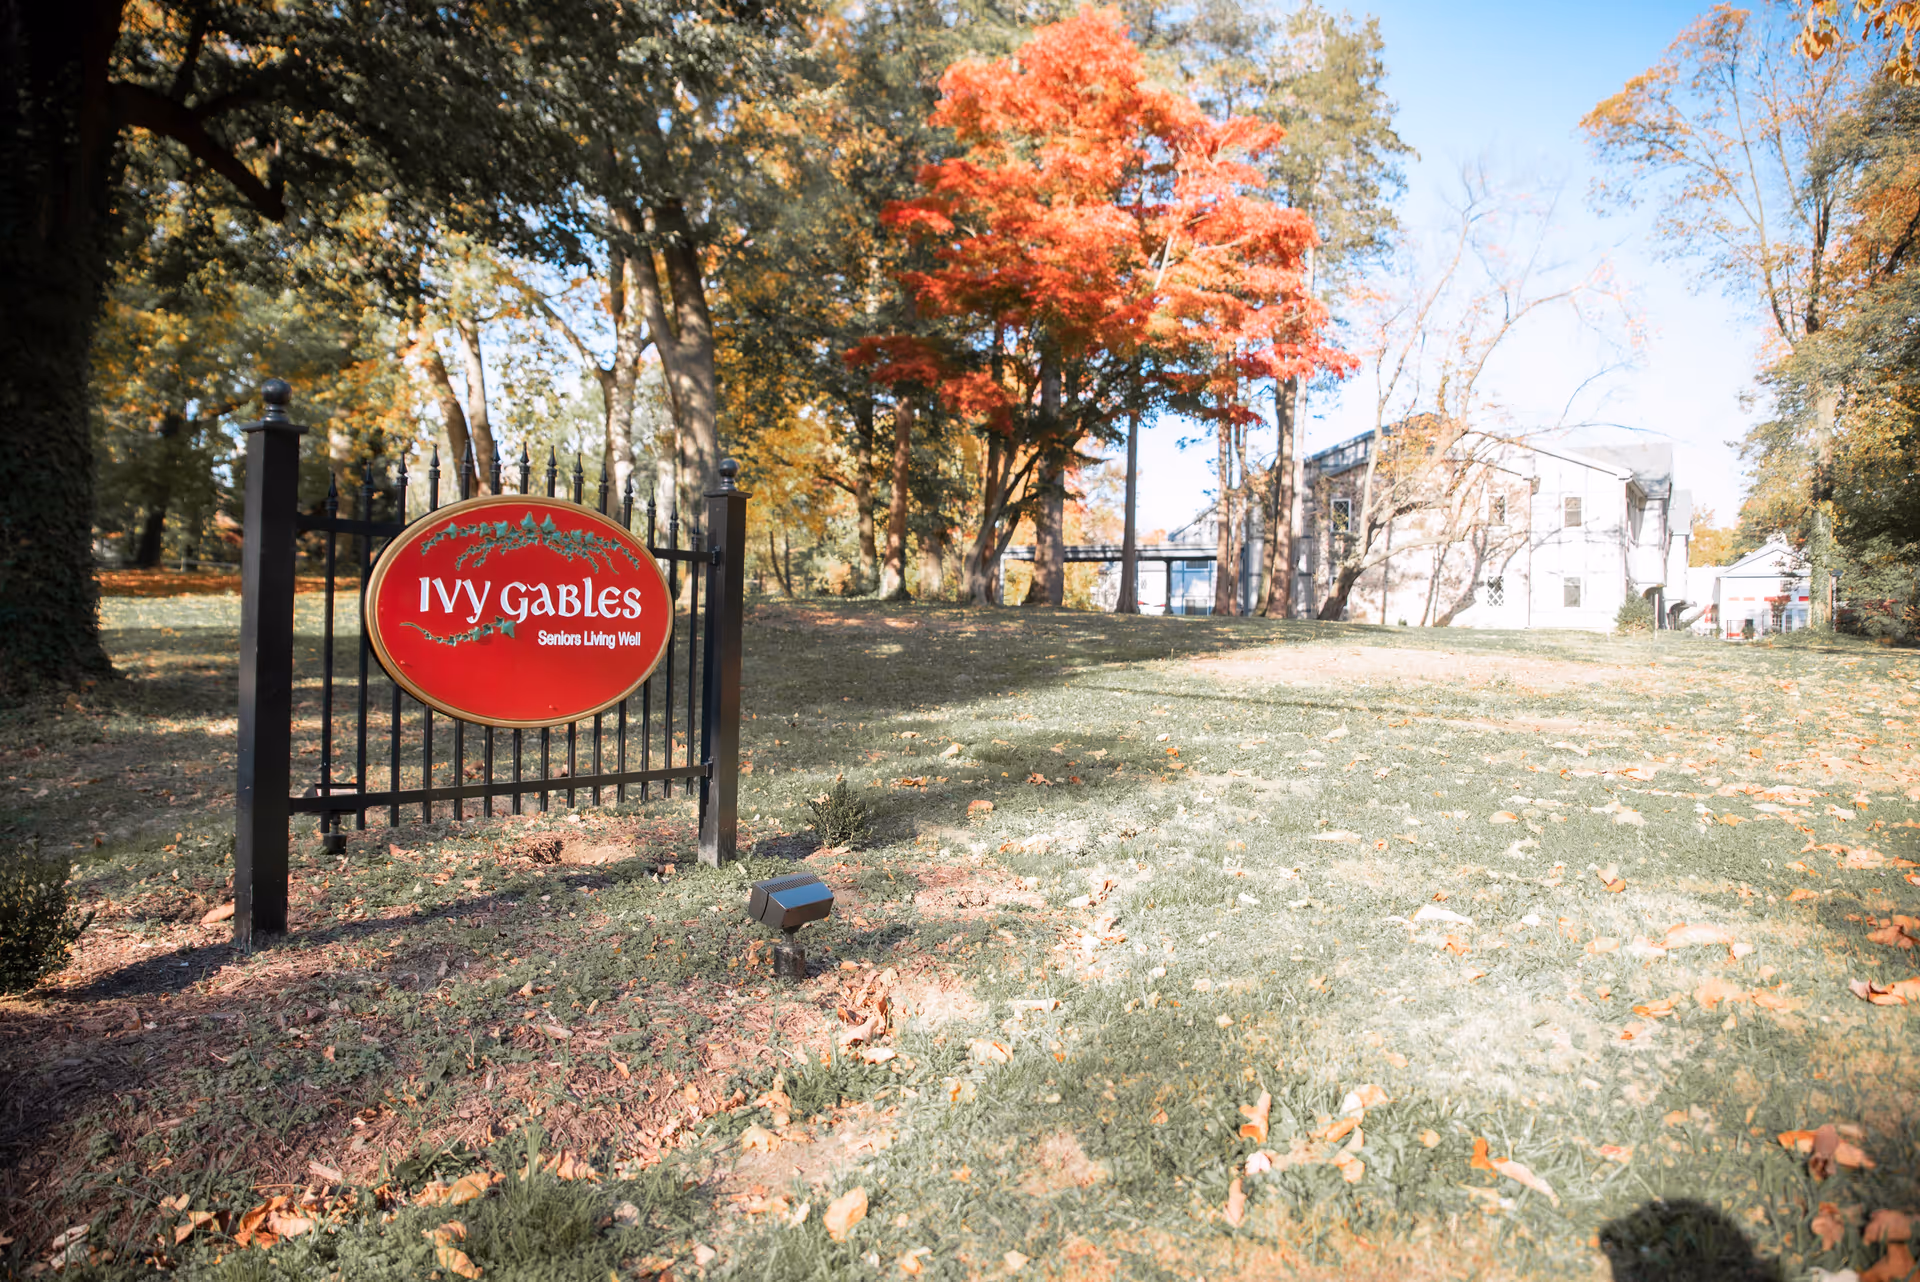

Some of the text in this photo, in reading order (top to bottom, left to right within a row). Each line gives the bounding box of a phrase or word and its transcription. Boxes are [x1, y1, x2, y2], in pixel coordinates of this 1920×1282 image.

[538, 630, 641, 649] Seniors Living Well
